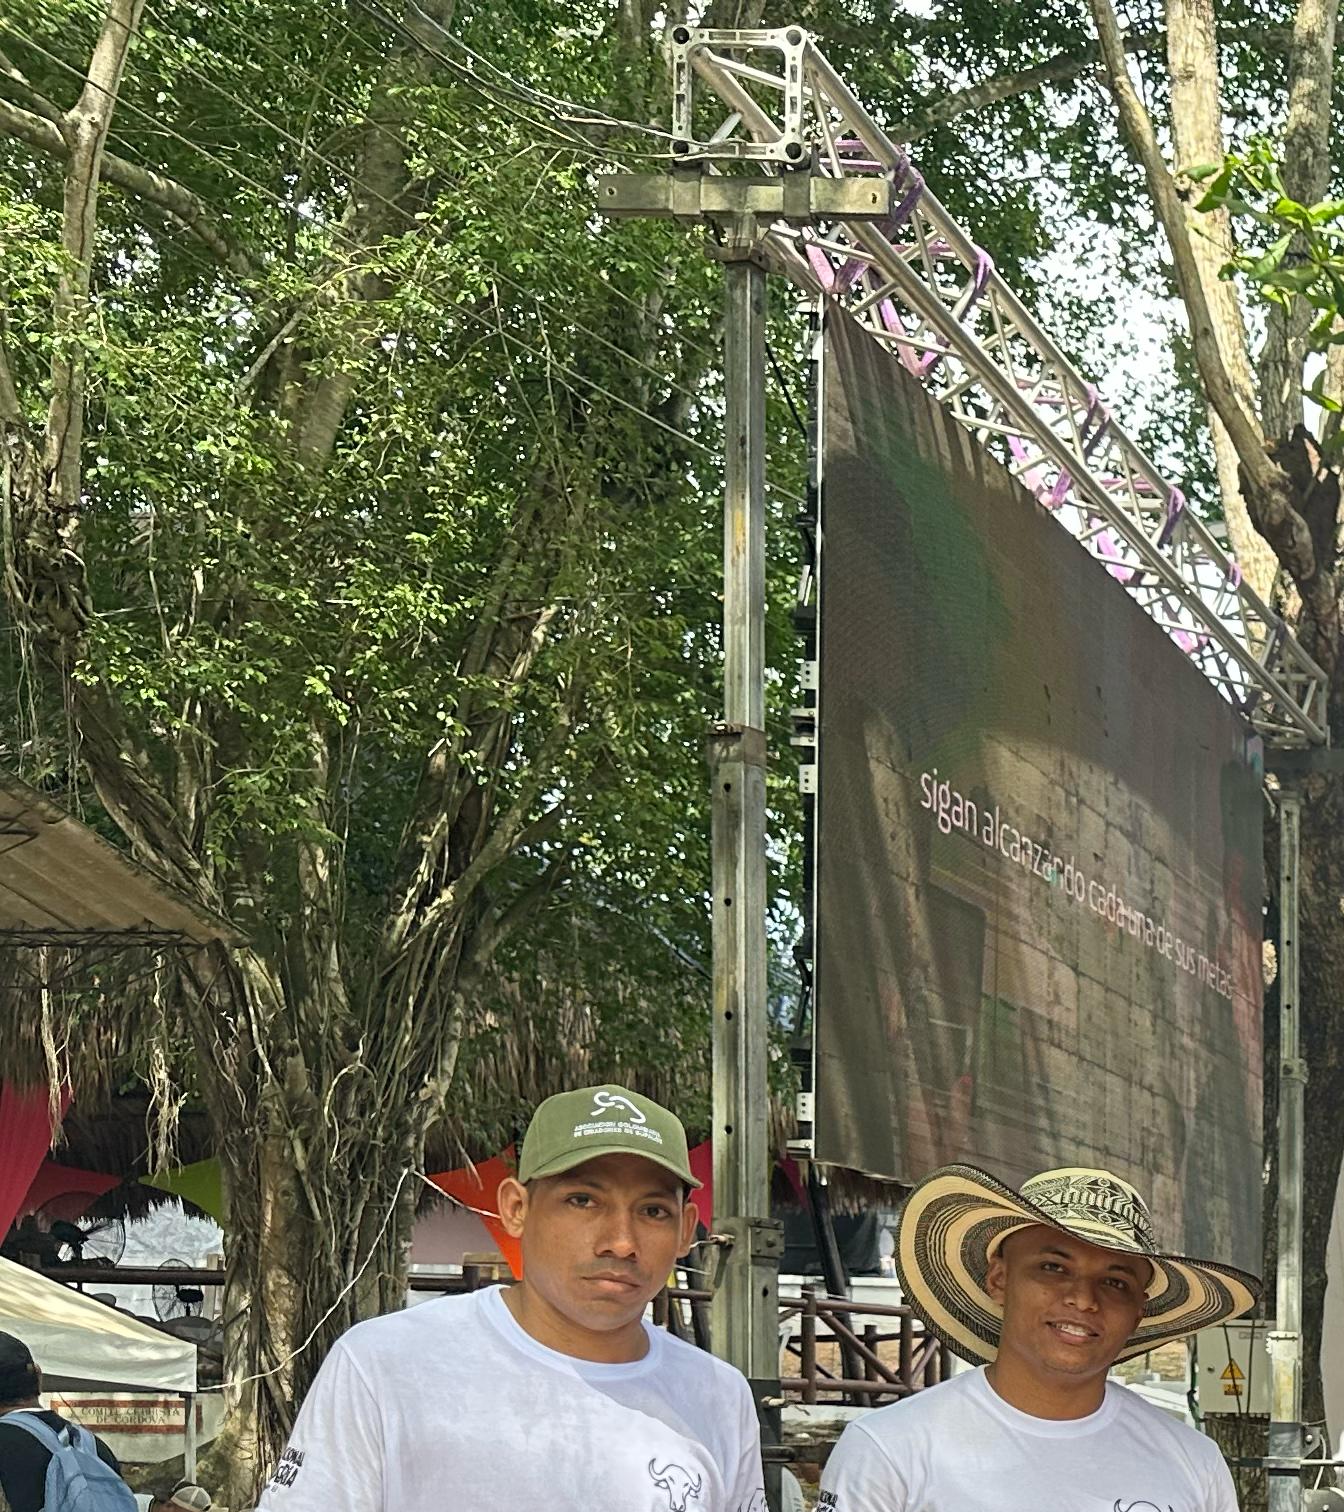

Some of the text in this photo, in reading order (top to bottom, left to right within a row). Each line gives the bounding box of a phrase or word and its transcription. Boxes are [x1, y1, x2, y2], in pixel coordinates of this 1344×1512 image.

[920, 768, 1233, 1000] sigan alcanzando cada una de sus metas
